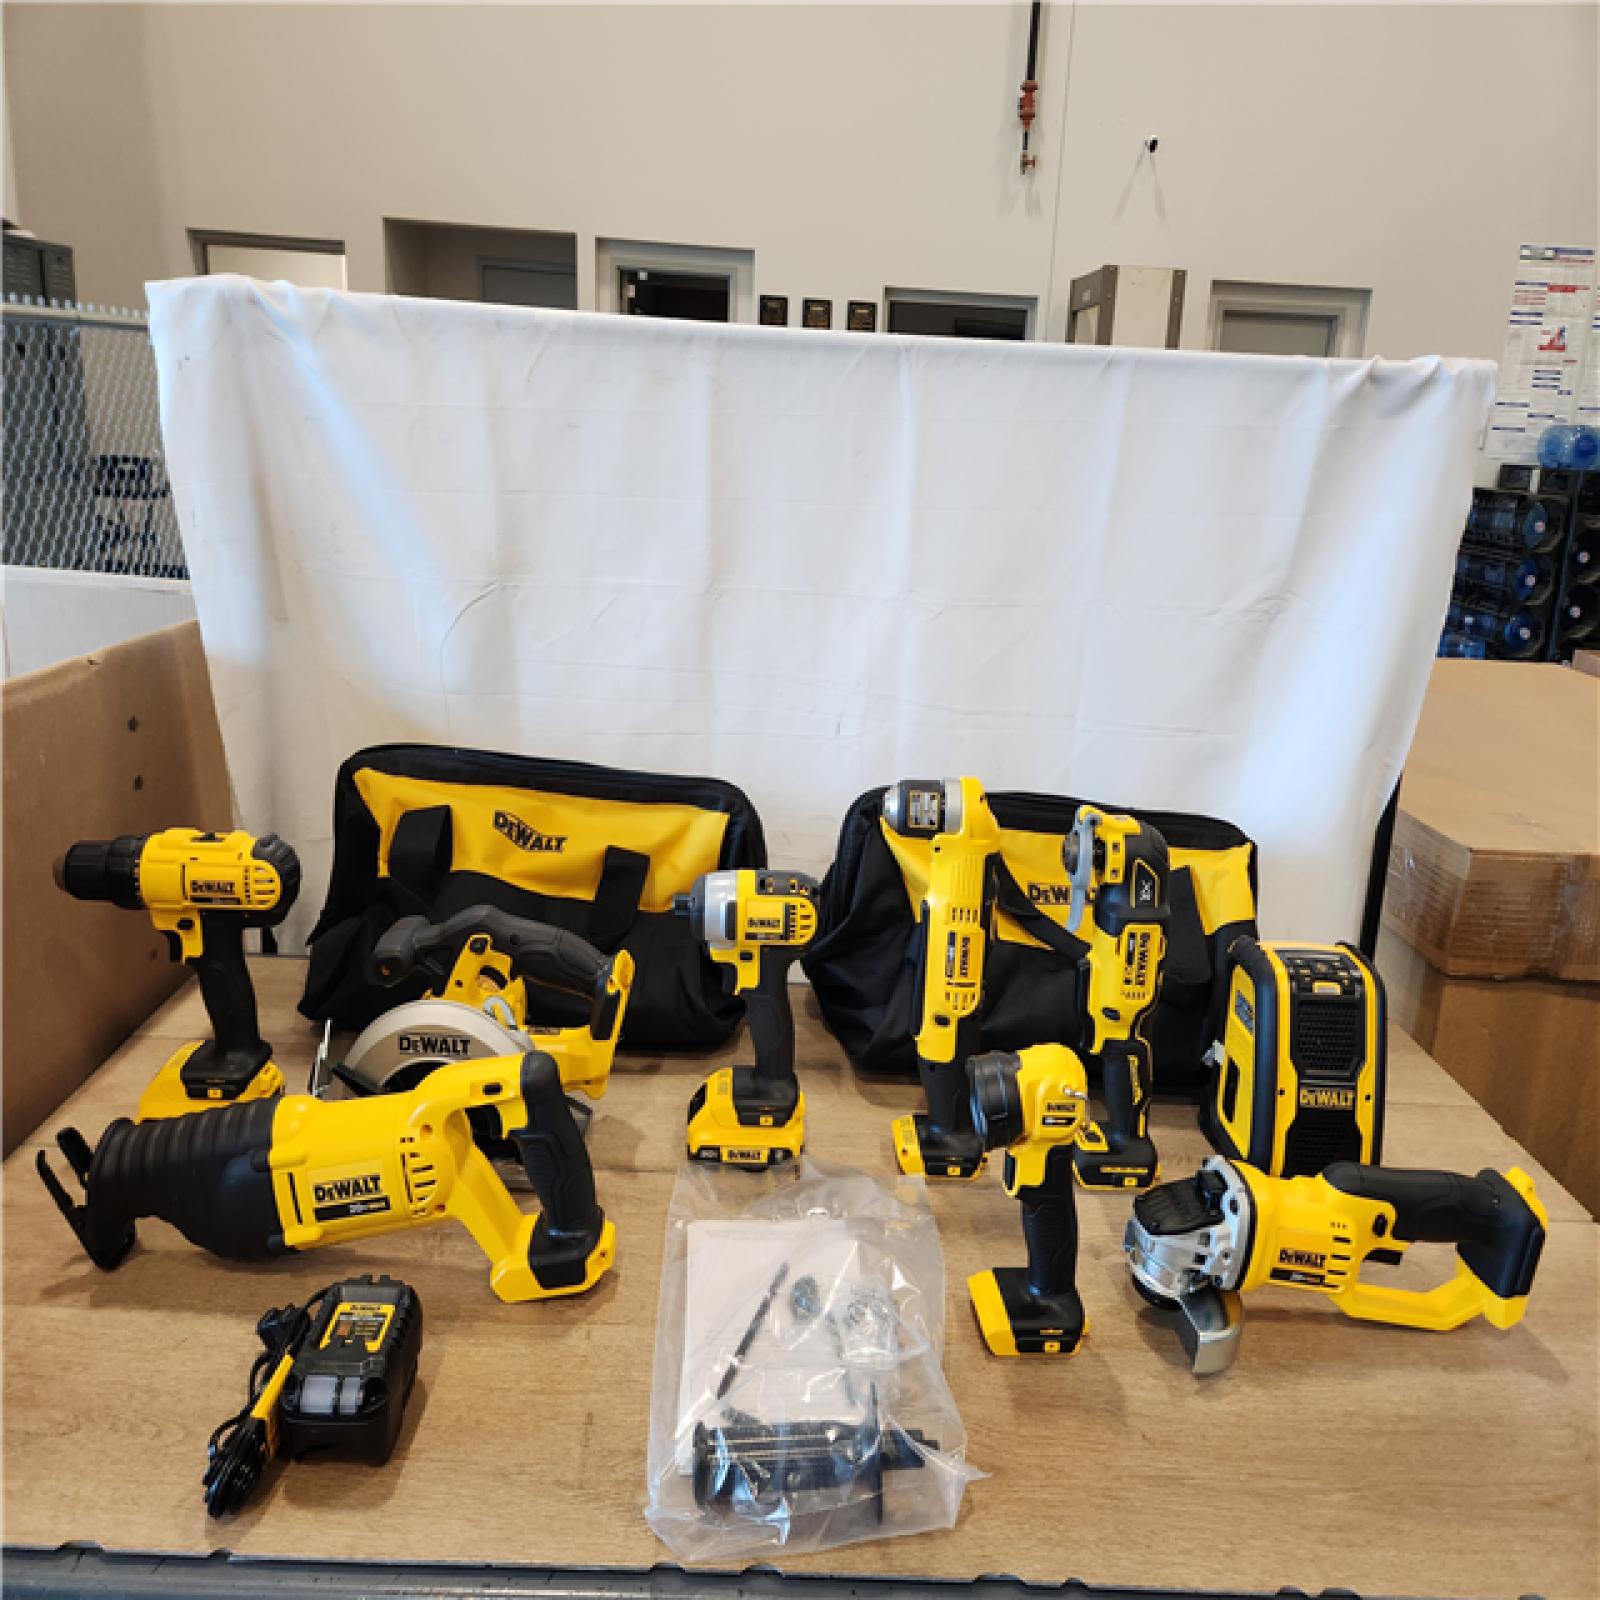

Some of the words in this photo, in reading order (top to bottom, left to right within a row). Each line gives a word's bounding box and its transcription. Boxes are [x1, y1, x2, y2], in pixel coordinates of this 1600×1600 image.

[494, 811, 566, 852] DEWALT
[399, 1035, 470, 1055] DEWALT
[1300, 1088, 1354, 1109] DEWALT
[314, 1174, 381, 1202] DEWALT
[1280, 1249, 1325, 1267] DEWALT
